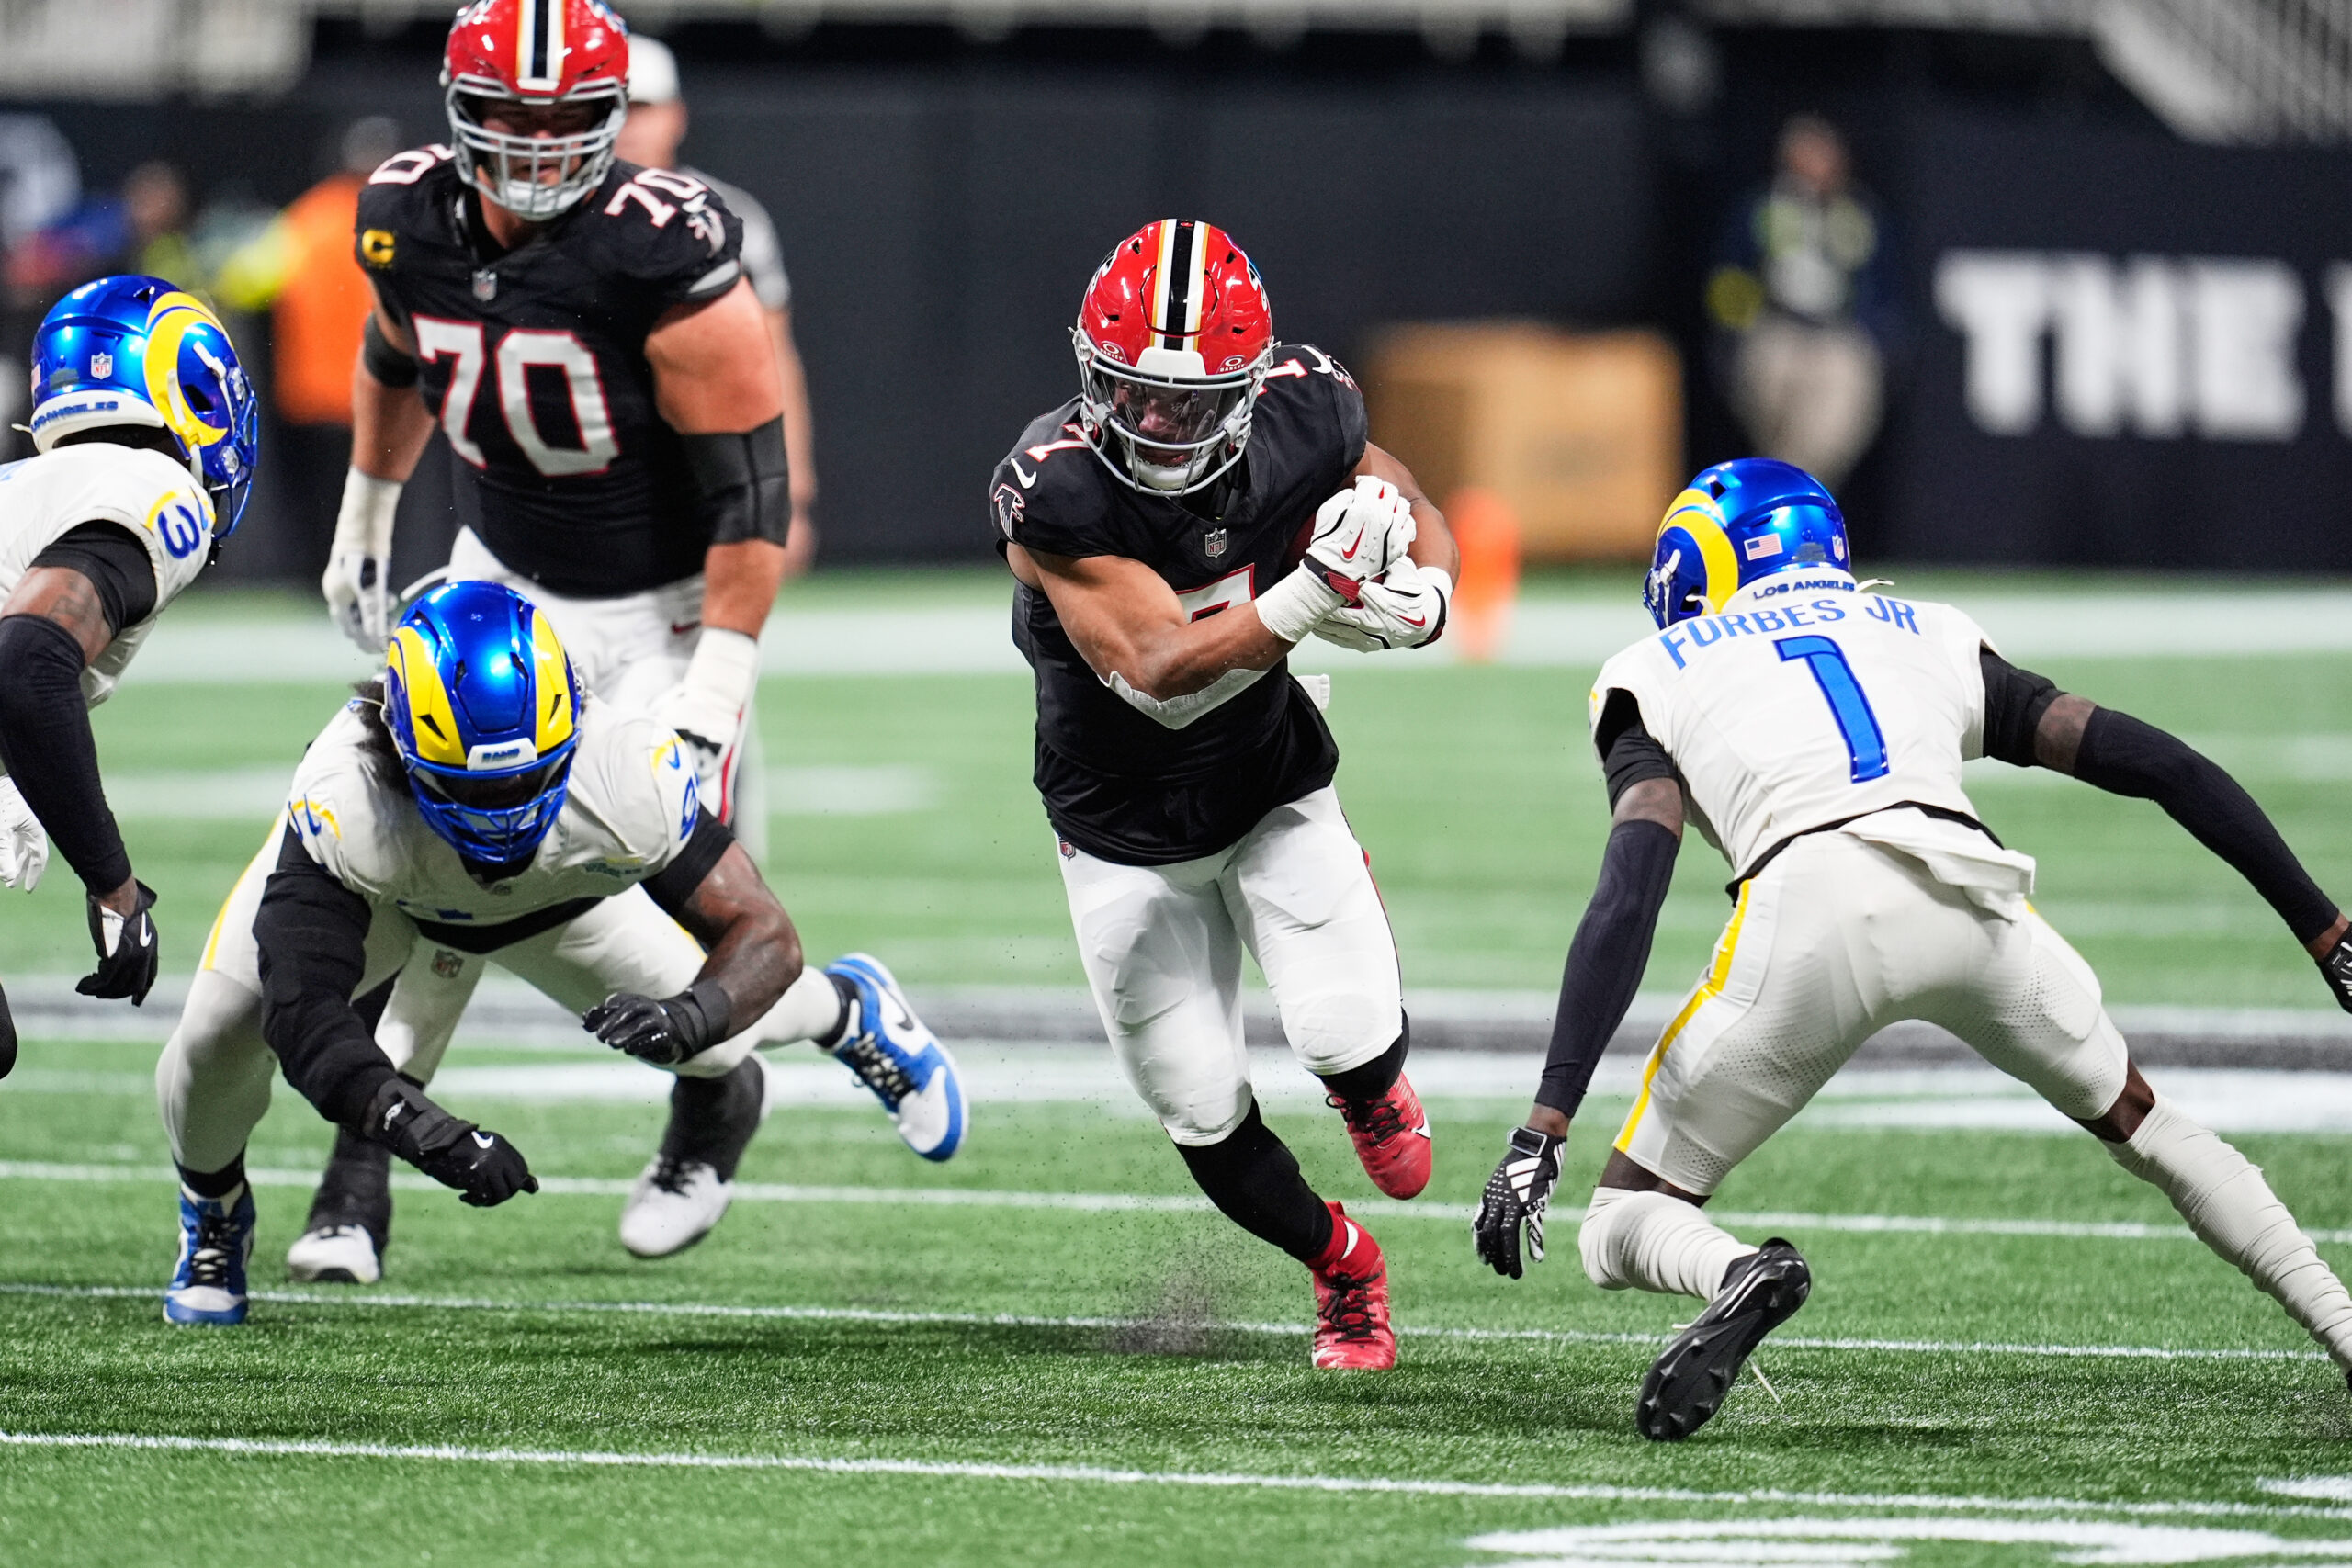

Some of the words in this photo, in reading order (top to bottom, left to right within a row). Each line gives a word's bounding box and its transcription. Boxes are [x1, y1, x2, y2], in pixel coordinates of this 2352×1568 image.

[604, 168, 708, 229] 70
[361, 229, 395, 265] C
[1936, 252, 2304, 438] THE
[412, 313, 621, 477] 70
[158, 505, 200, 559] 3
[1209, 541, 1224, 554] NFL
[1752, 583, 1790, 600] LOS
[1792, 580, 1855, 592] ANGELES
[1659, 599, 1846, 671] FORBES
[1865, 596, 1920, 636] JR
[1771, 634, 1890, 784] 1
